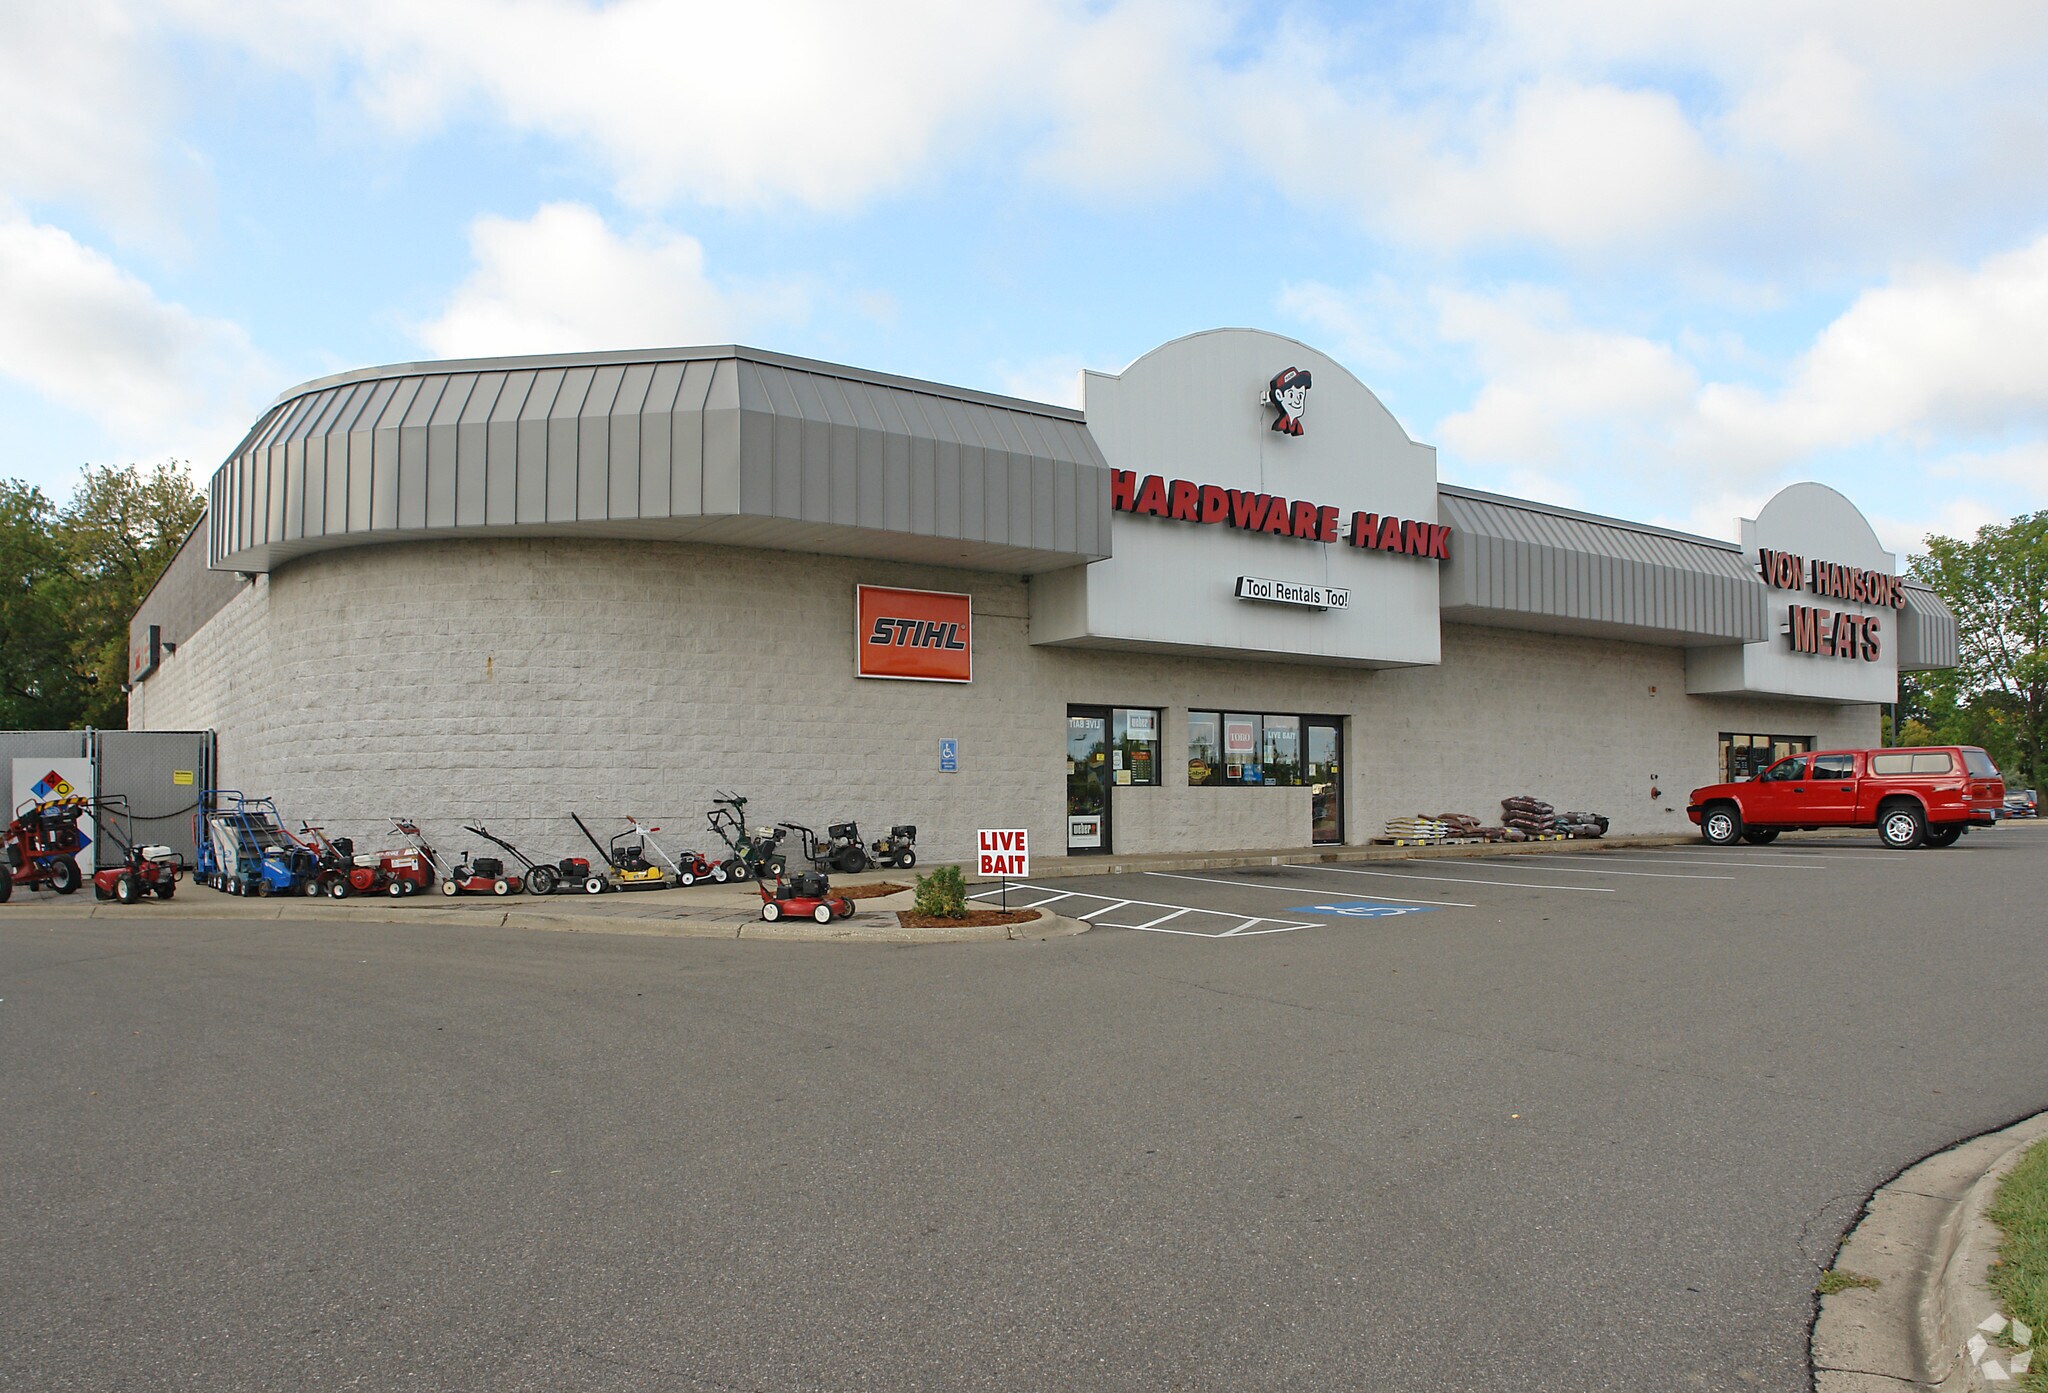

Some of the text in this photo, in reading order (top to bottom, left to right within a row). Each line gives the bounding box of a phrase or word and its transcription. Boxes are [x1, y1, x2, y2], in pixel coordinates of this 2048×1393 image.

[1111, 468, 1451, 560] HARDWARE HANK
[1759, 548, 1905, 610] VON HANSON'S
[1246, 579, 1348, 607] Tool Rentals Too!
[868, 616, 966, 651] STIHL
[1789, 604, 1881, 662] MEATS
[1231, 732, 1251, 742] TORO
[47, 774, 55, 784] 4
[1073, 822, 1091, 835] weber
[980, 831, 1026, 851] LIVE
[981, 855, 1026, 875] BAIT
